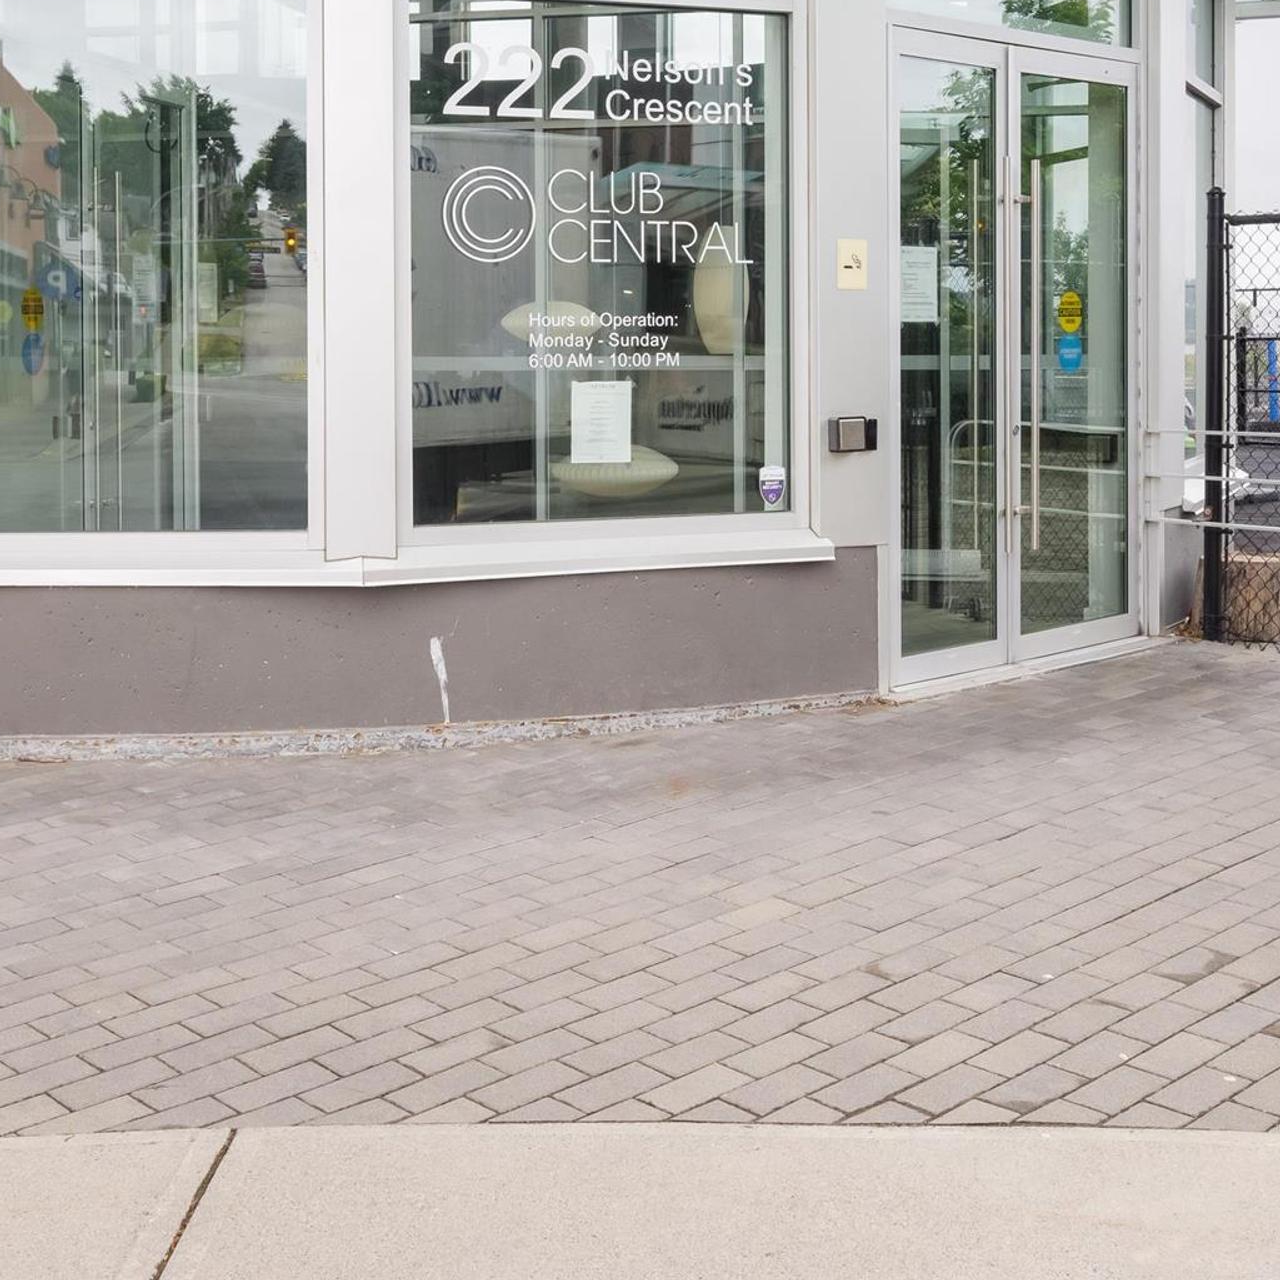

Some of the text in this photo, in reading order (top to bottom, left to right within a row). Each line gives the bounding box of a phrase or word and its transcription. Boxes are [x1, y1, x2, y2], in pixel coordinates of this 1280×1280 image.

[442, 41, 596, 120] 222
[605, 89, 754, 126] Crescent
[548, 169, 664, 214] CLUB
[548, 219, 754, 263] CENTRAL
[528, 312, 679, 330] Hours of Operation:
[528, 332, 594, 351] Monday
[608, 332, 669, 351] Sunday
[528, 352, 563, 368] 6:00
[566, 352, 593, 368] AM
[609, 352, 651, 368] 10:00
[655, 352, 681, 367] PM
